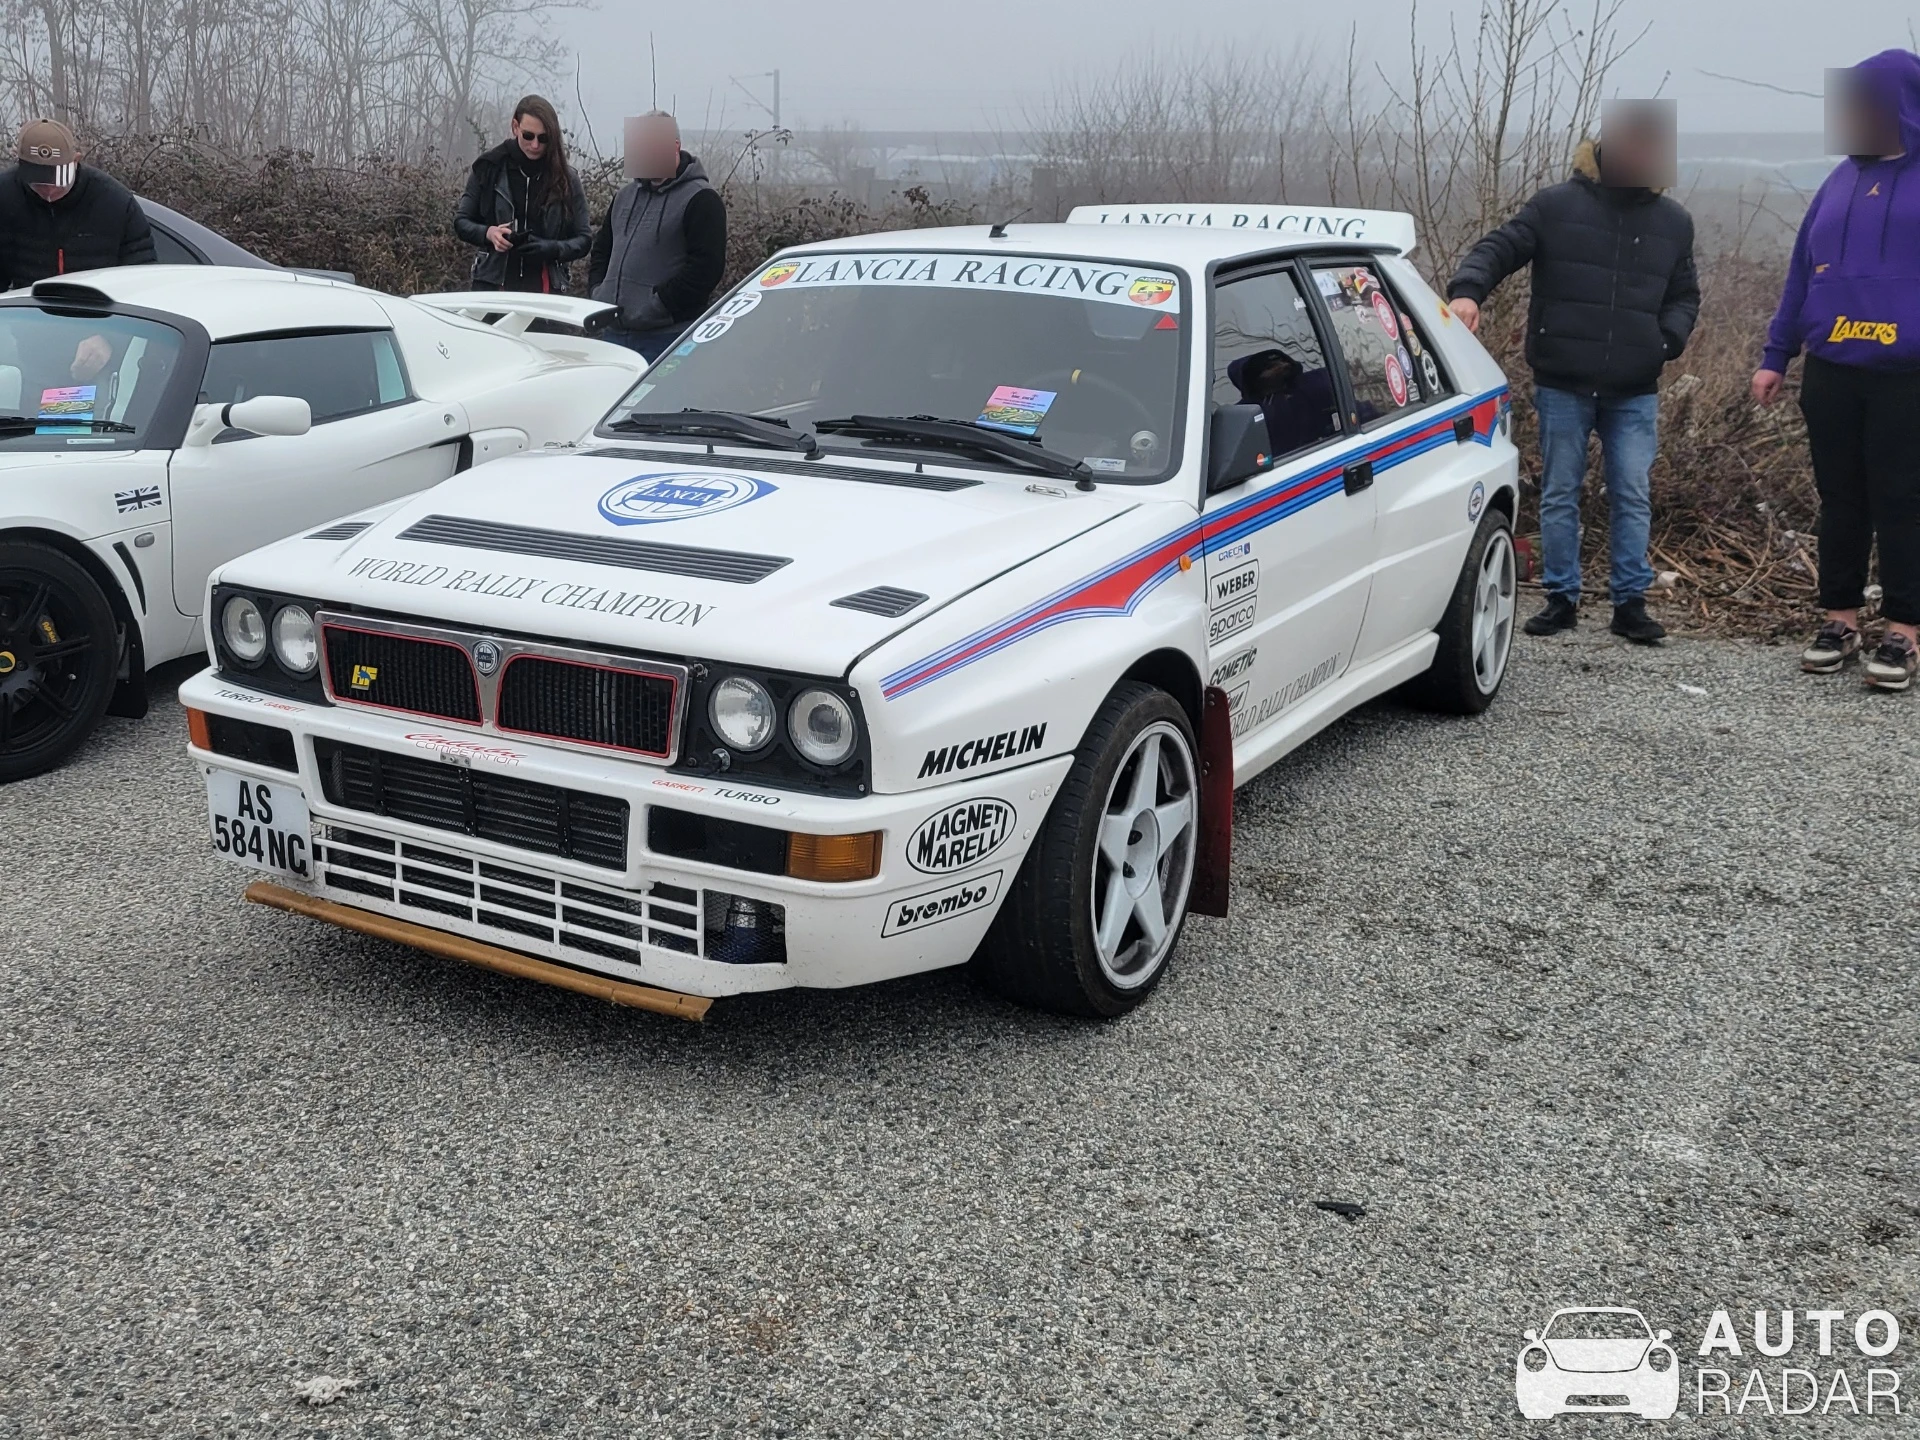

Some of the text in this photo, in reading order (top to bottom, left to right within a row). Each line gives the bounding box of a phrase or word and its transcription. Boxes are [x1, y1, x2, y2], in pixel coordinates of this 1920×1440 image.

[792, 258, 1130, 296] LANCIA RACING
[723, 298, 755, 315] 17
[697, 321, 726, 339] 10
[1827, 315, 1898, 346] LAKERS
[641, 487, 715, 503] LANCIA
[347, 557, 718, 628] WORLD RALLY CHAMPION
[1216, 569, 1256, 600] WEBER
[1209, 604, 1254, 641] sparco
[1209, 647, 1258, 686] COMETIC
[213, 689, 264, 704] TURBO
[1231, 704, 1258, 741] ORLD
[1255, 682, 1293, 728] RALLY
[916, 721, 1048, 780] MICHELIN
[238, 780, 273, 825] AS
[651, 779, 782, 805] GARRETT TURBO
[896, 885, 988, 928] brembo
